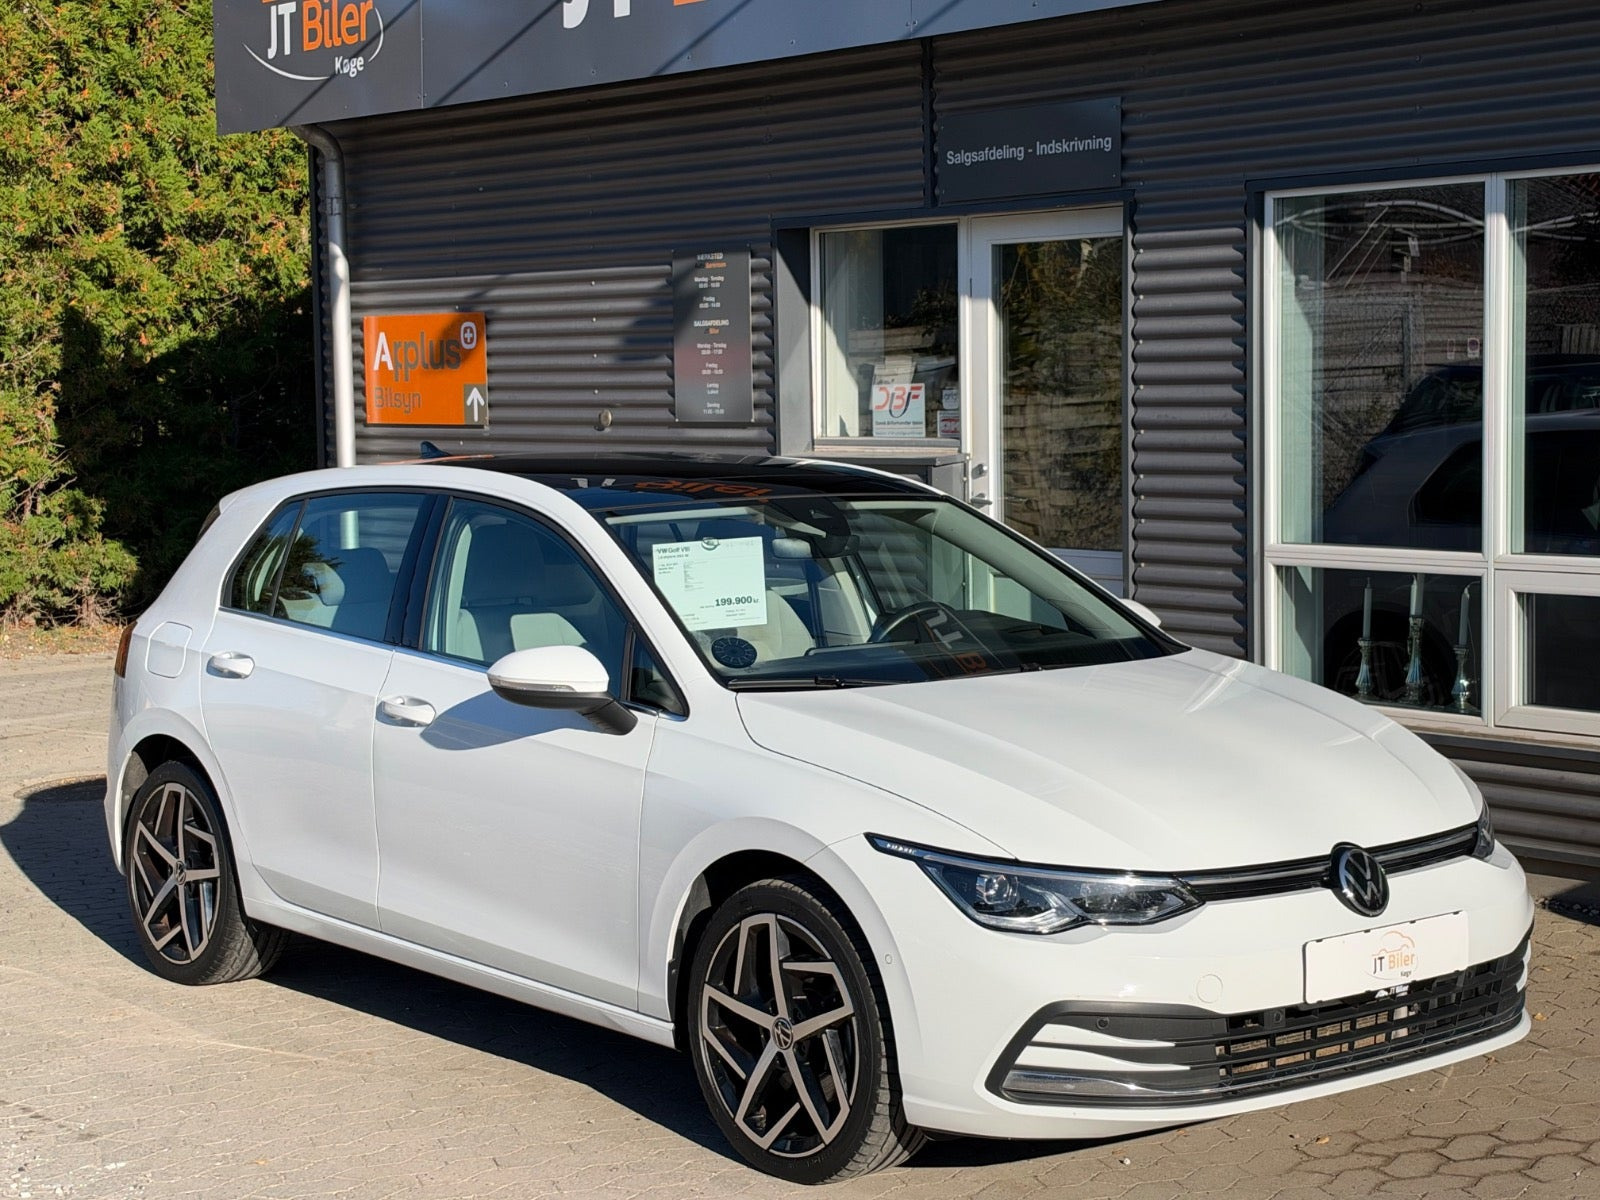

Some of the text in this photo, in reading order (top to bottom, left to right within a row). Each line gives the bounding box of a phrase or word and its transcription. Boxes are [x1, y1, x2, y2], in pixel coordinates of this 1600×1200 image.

[267, 0, 374, 60] JT Biler
[334, 56, 365, 78] Køge
[946, 144, 1025, 167] Salgsafdeling
[1036, 135, 1113, 156] Indskrivning
[374, 386, 421, 415] Bilsyn
[715, 595, 753, 607] 199.900
[1373, 951, 1416, 975] JT Biler
